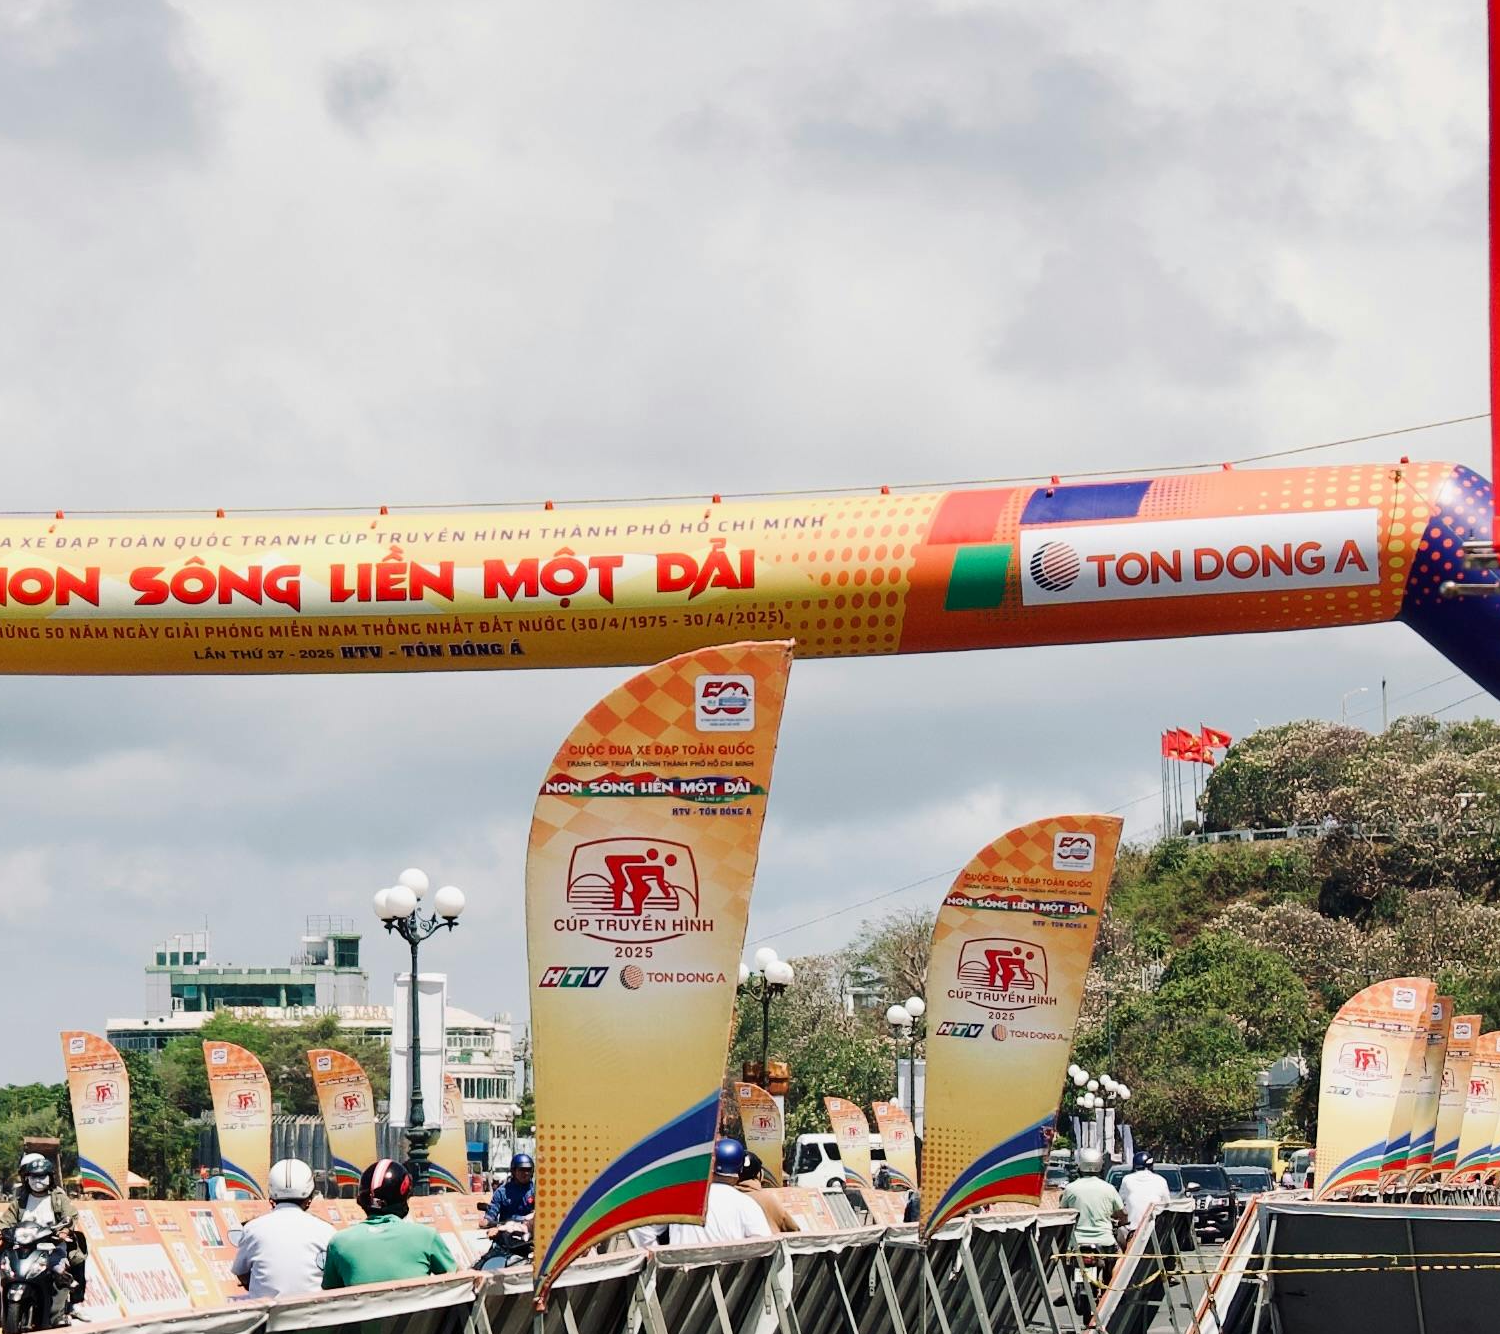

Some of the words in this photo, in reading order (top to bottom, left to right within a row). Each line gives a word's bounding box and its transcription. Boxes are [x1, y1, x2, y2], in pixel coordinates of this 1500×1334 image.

[20, 536, 46, 548] XE
[56, 536, 98, 552] ĐẠP
[108, 534, 166, 548] TOÀN
[174, 533, 232, 550] QUỐC
[241, 534, 316, 547] TRANH
[325, 530, 368, 545] CÚP
[376, 526, 465, 544] TRUYỀN
[474, 527, 530, 541] HÌNH
[541, 523, 618, 539] THÀNH
[626, 519, 672, 535] PHỐ
[718, 517, 756, 532] CHÍ
[1086, 550, 1181, 588] TON
[1194, 541, 1323, 583] DONG
[1330, 538, 1369, 573] A
[128, 555, 301, 613] SÔNG
[330, 545, 454, 602] LIỀN
[483, 546, 624, 608] MỘT
[656, 538, 755, 600] DẢI
[45, 627, 63, 639] 50
[70, 624, 107, 639] NĂM
[113, 623, 159, 639] NGÀY
[205, 623, 264, 638] PHÓNG
[272, 619, 312, 637] MIỀN
[318, 622, 357, 637] NAM
[362, 618, 421, 636] THỐNG
[427, 619, 474, 635] NHẤT
[479, 619, 514, 634] ĐẤT
[518, 615, 565, 632] NƯỚC
[231, 646, 262, 659] THỨ
[267, 649, 284, 659] 37
[299, 649, 334, 659] 2025
[341, 645, 382, 660] HTV
[401, 641, 443, 658] TÔN
[569, 745, 605, 755] CUỘC
[609, 745, 632, 755] ĐUA
[637, 745, 650, 754] XE
[655, 745, 678, 757] ĐẠP
[682, 743, 715, 755] TOÀN
[718, 742, 754, 755] QUỐC
[546, 782, 582, 793] NON
[589, 779, 634, 793] SÔNG
[641, 777, 674, 793] LIỀN
[680, 781, 716, 795] MỘT
[724, 778, 750, 793] DẢI
[554, 915, 589, 931] CÚP
[595, 914, 666, 931] TRUYỀN
[672, 916, 713, 931] HÌNH
[615, 947, 653, 958] 2025
[542, 969, 604, 985] HTV
[647, 972, 674, 983] TON
[677, 972, 714, 983] DONG
[716, 974, 726, 983] A
[938, 1023, 982, 1036] HTV
